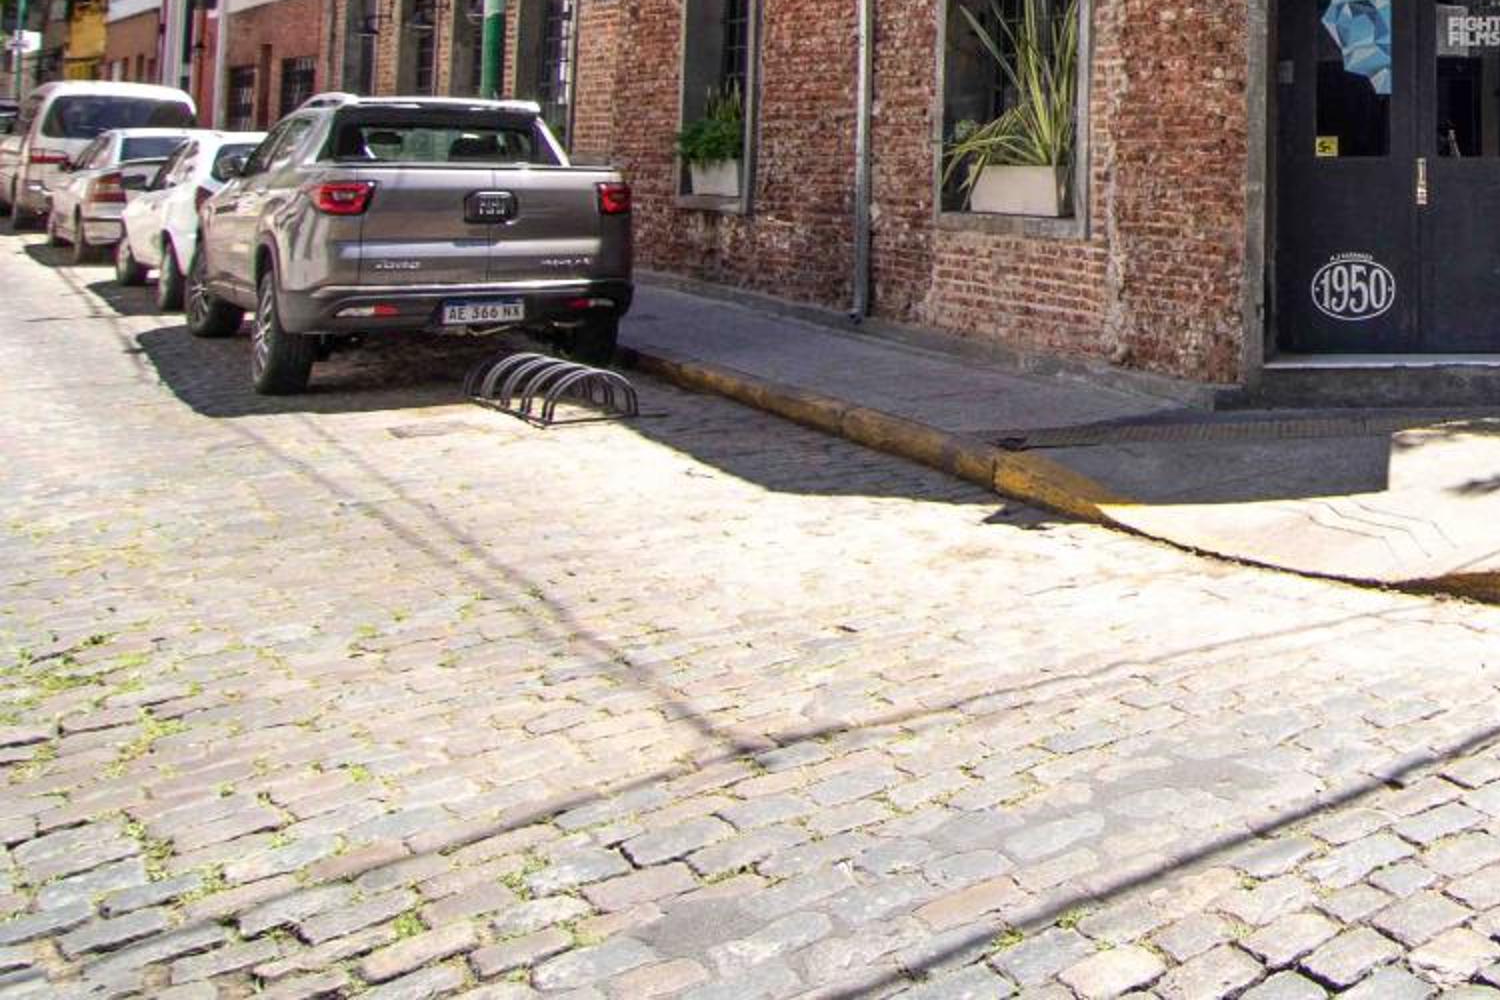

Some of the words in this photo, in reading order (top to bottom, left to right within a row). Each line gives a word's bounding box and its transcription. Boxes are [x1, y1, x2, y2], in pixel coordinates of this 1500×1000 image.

[1448, 31, 1500, 47] FILMS
[1320, 265, 1387, 313] 1950
[449, 307, 466, 321] AE
